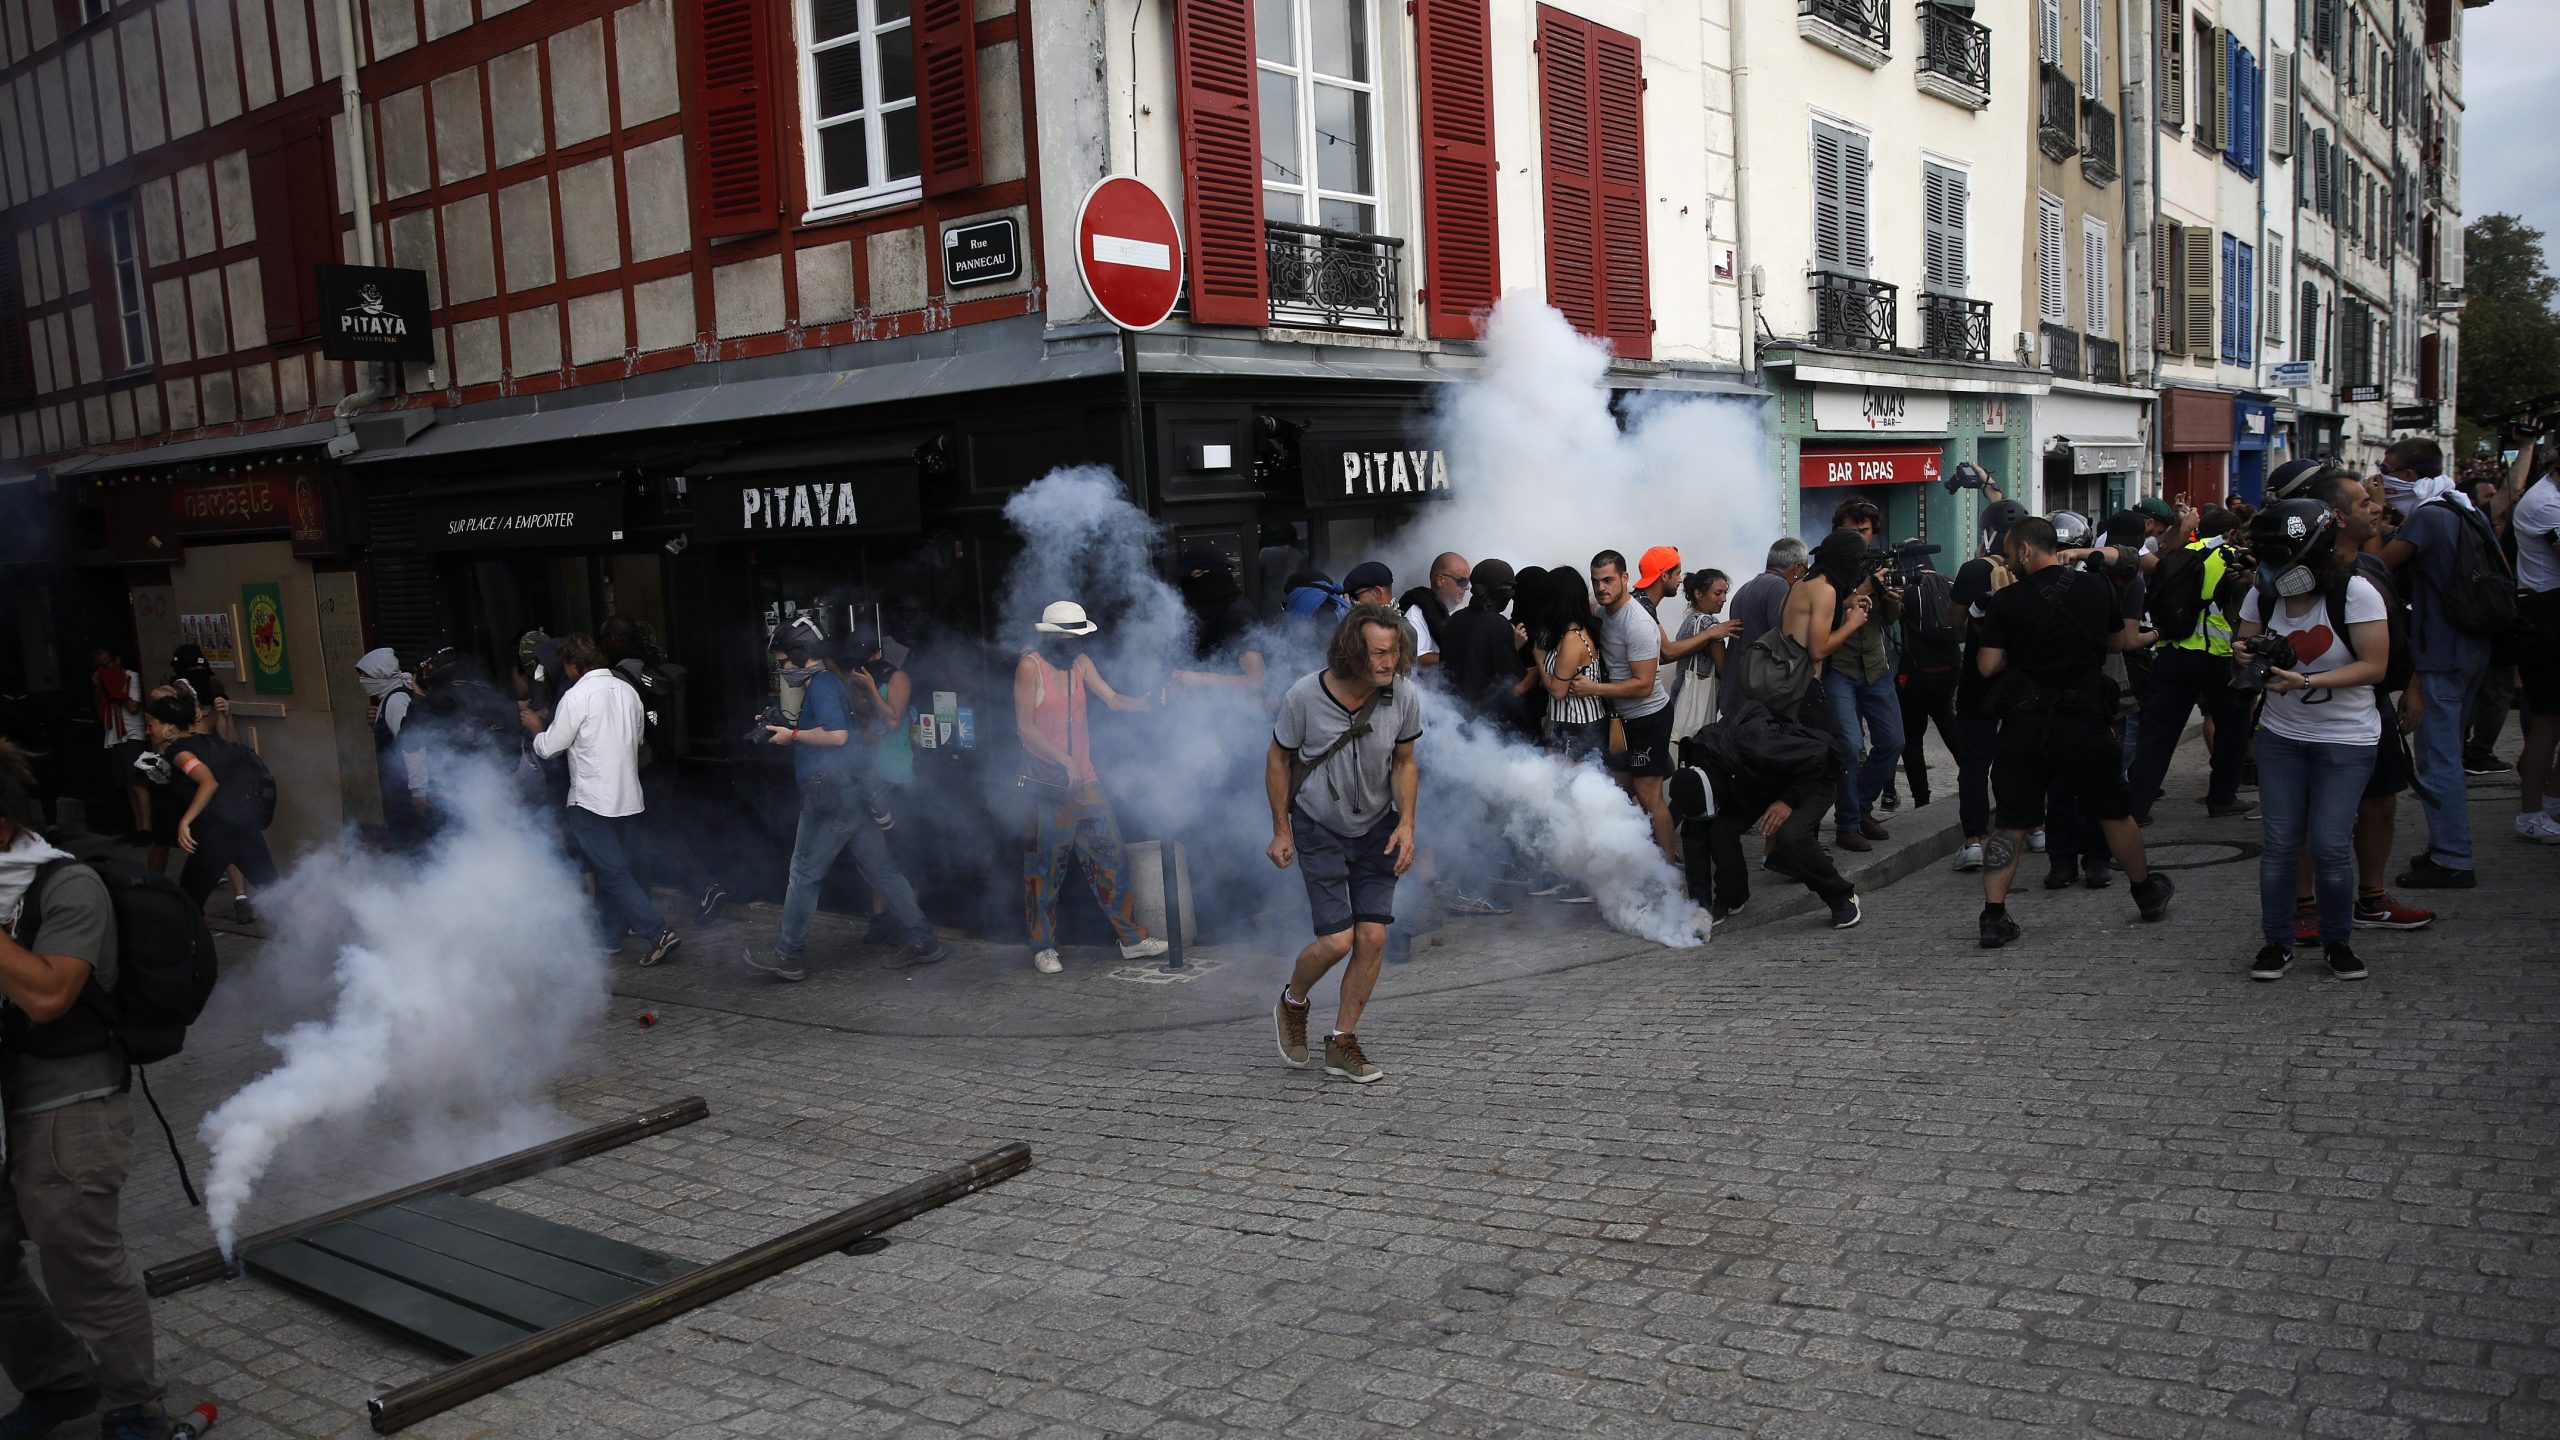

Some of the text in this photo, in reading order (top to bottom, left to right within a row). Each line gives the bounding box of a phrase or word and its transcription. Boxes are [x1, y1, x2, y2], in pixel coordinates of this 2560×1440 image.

[970, 239, 988, 250] Rue
[956, 253, 1006, 272] PANNECAU
[1883, 418, 1896, 427] BAR
[1987, 400, 2003, 425] 24
[1828, 461, 1895, 482] BAR TAPAS
[447, 519, 465, 535] SUR
[466, 516, 498, 532] PLACE
[503, 516, 513, 530] A
[514, 512, 573, 529] EMPORTER
